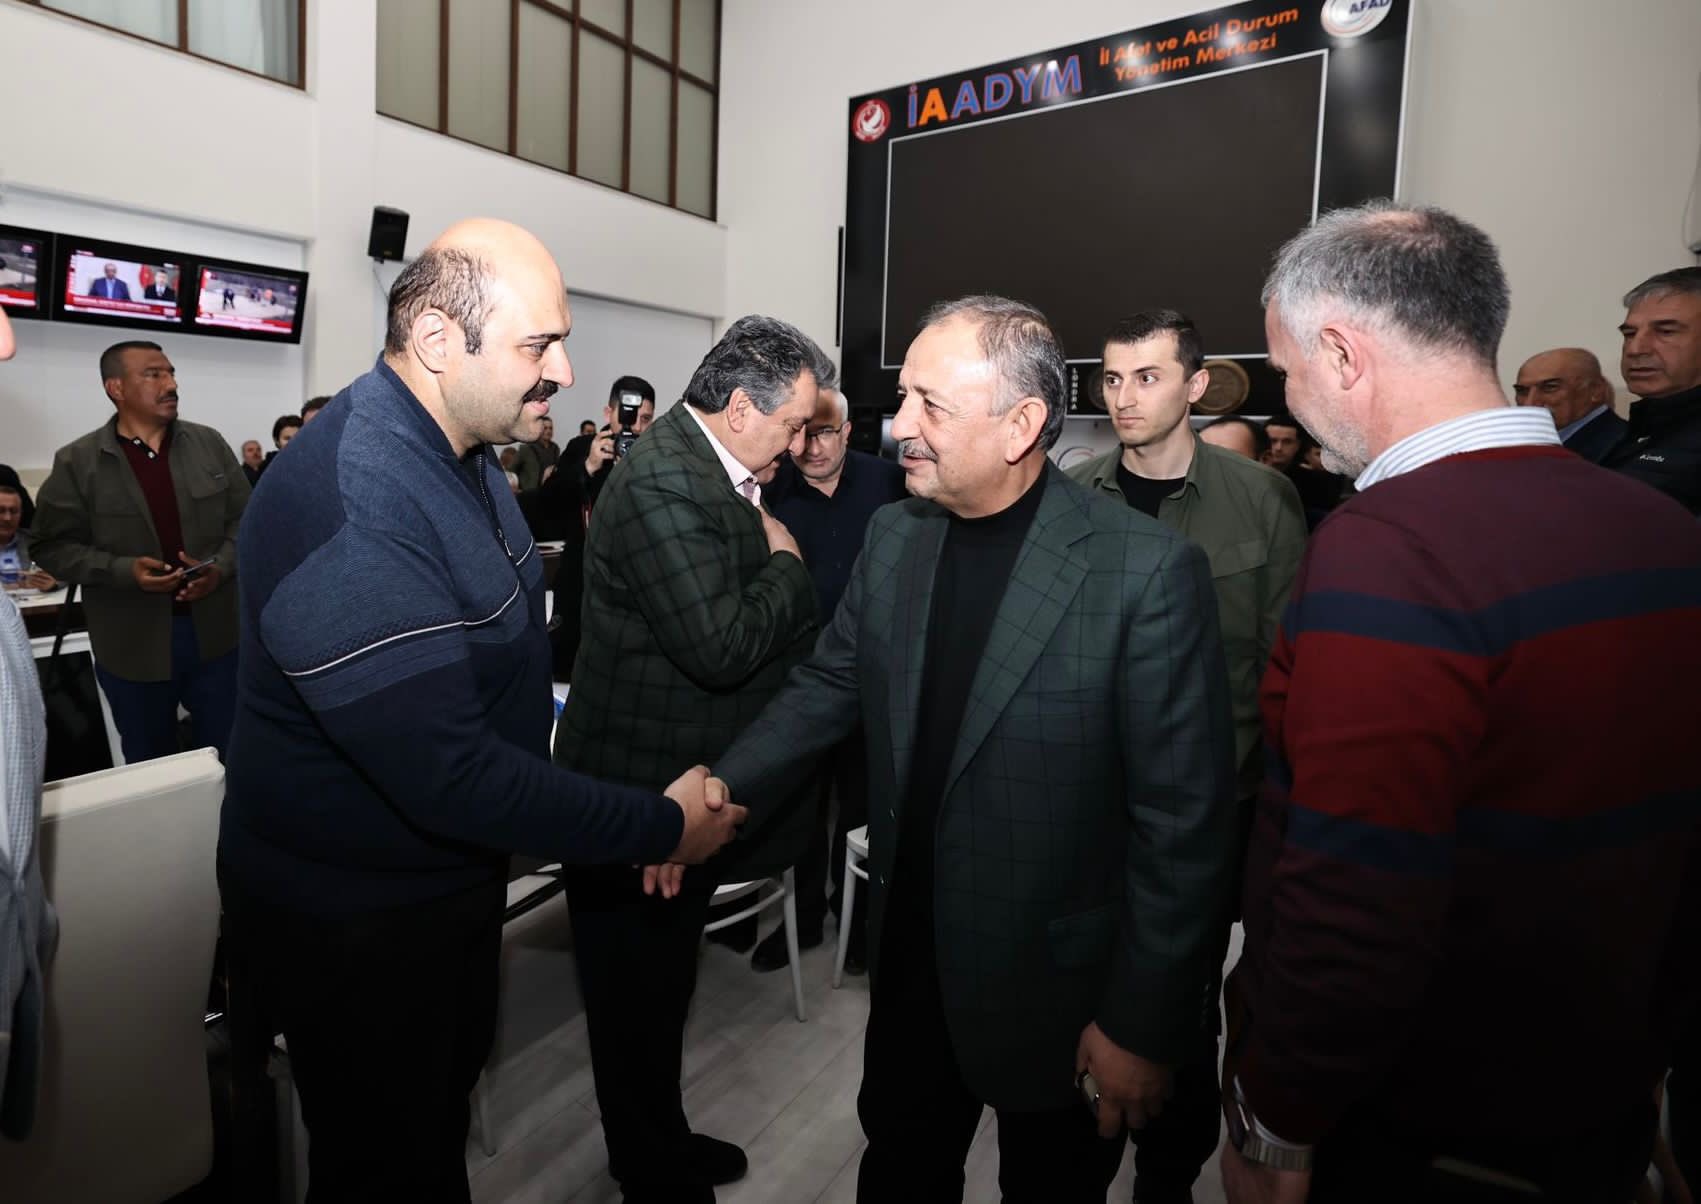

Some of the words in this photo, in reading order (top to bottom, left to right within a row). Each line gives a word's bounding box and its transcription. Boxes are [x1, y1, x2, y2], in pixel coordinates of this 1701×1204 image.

[1349, 0, 1389, 14] AFAD
[1156, 37, 1178, 53] ve
[1183, 24, 1219, 47] Acil
[1226, 8, 1299, 35] Durum
[1195, 32, 1278, 65] Merkezi
[907, 54, 1082, 128] İAADYM
